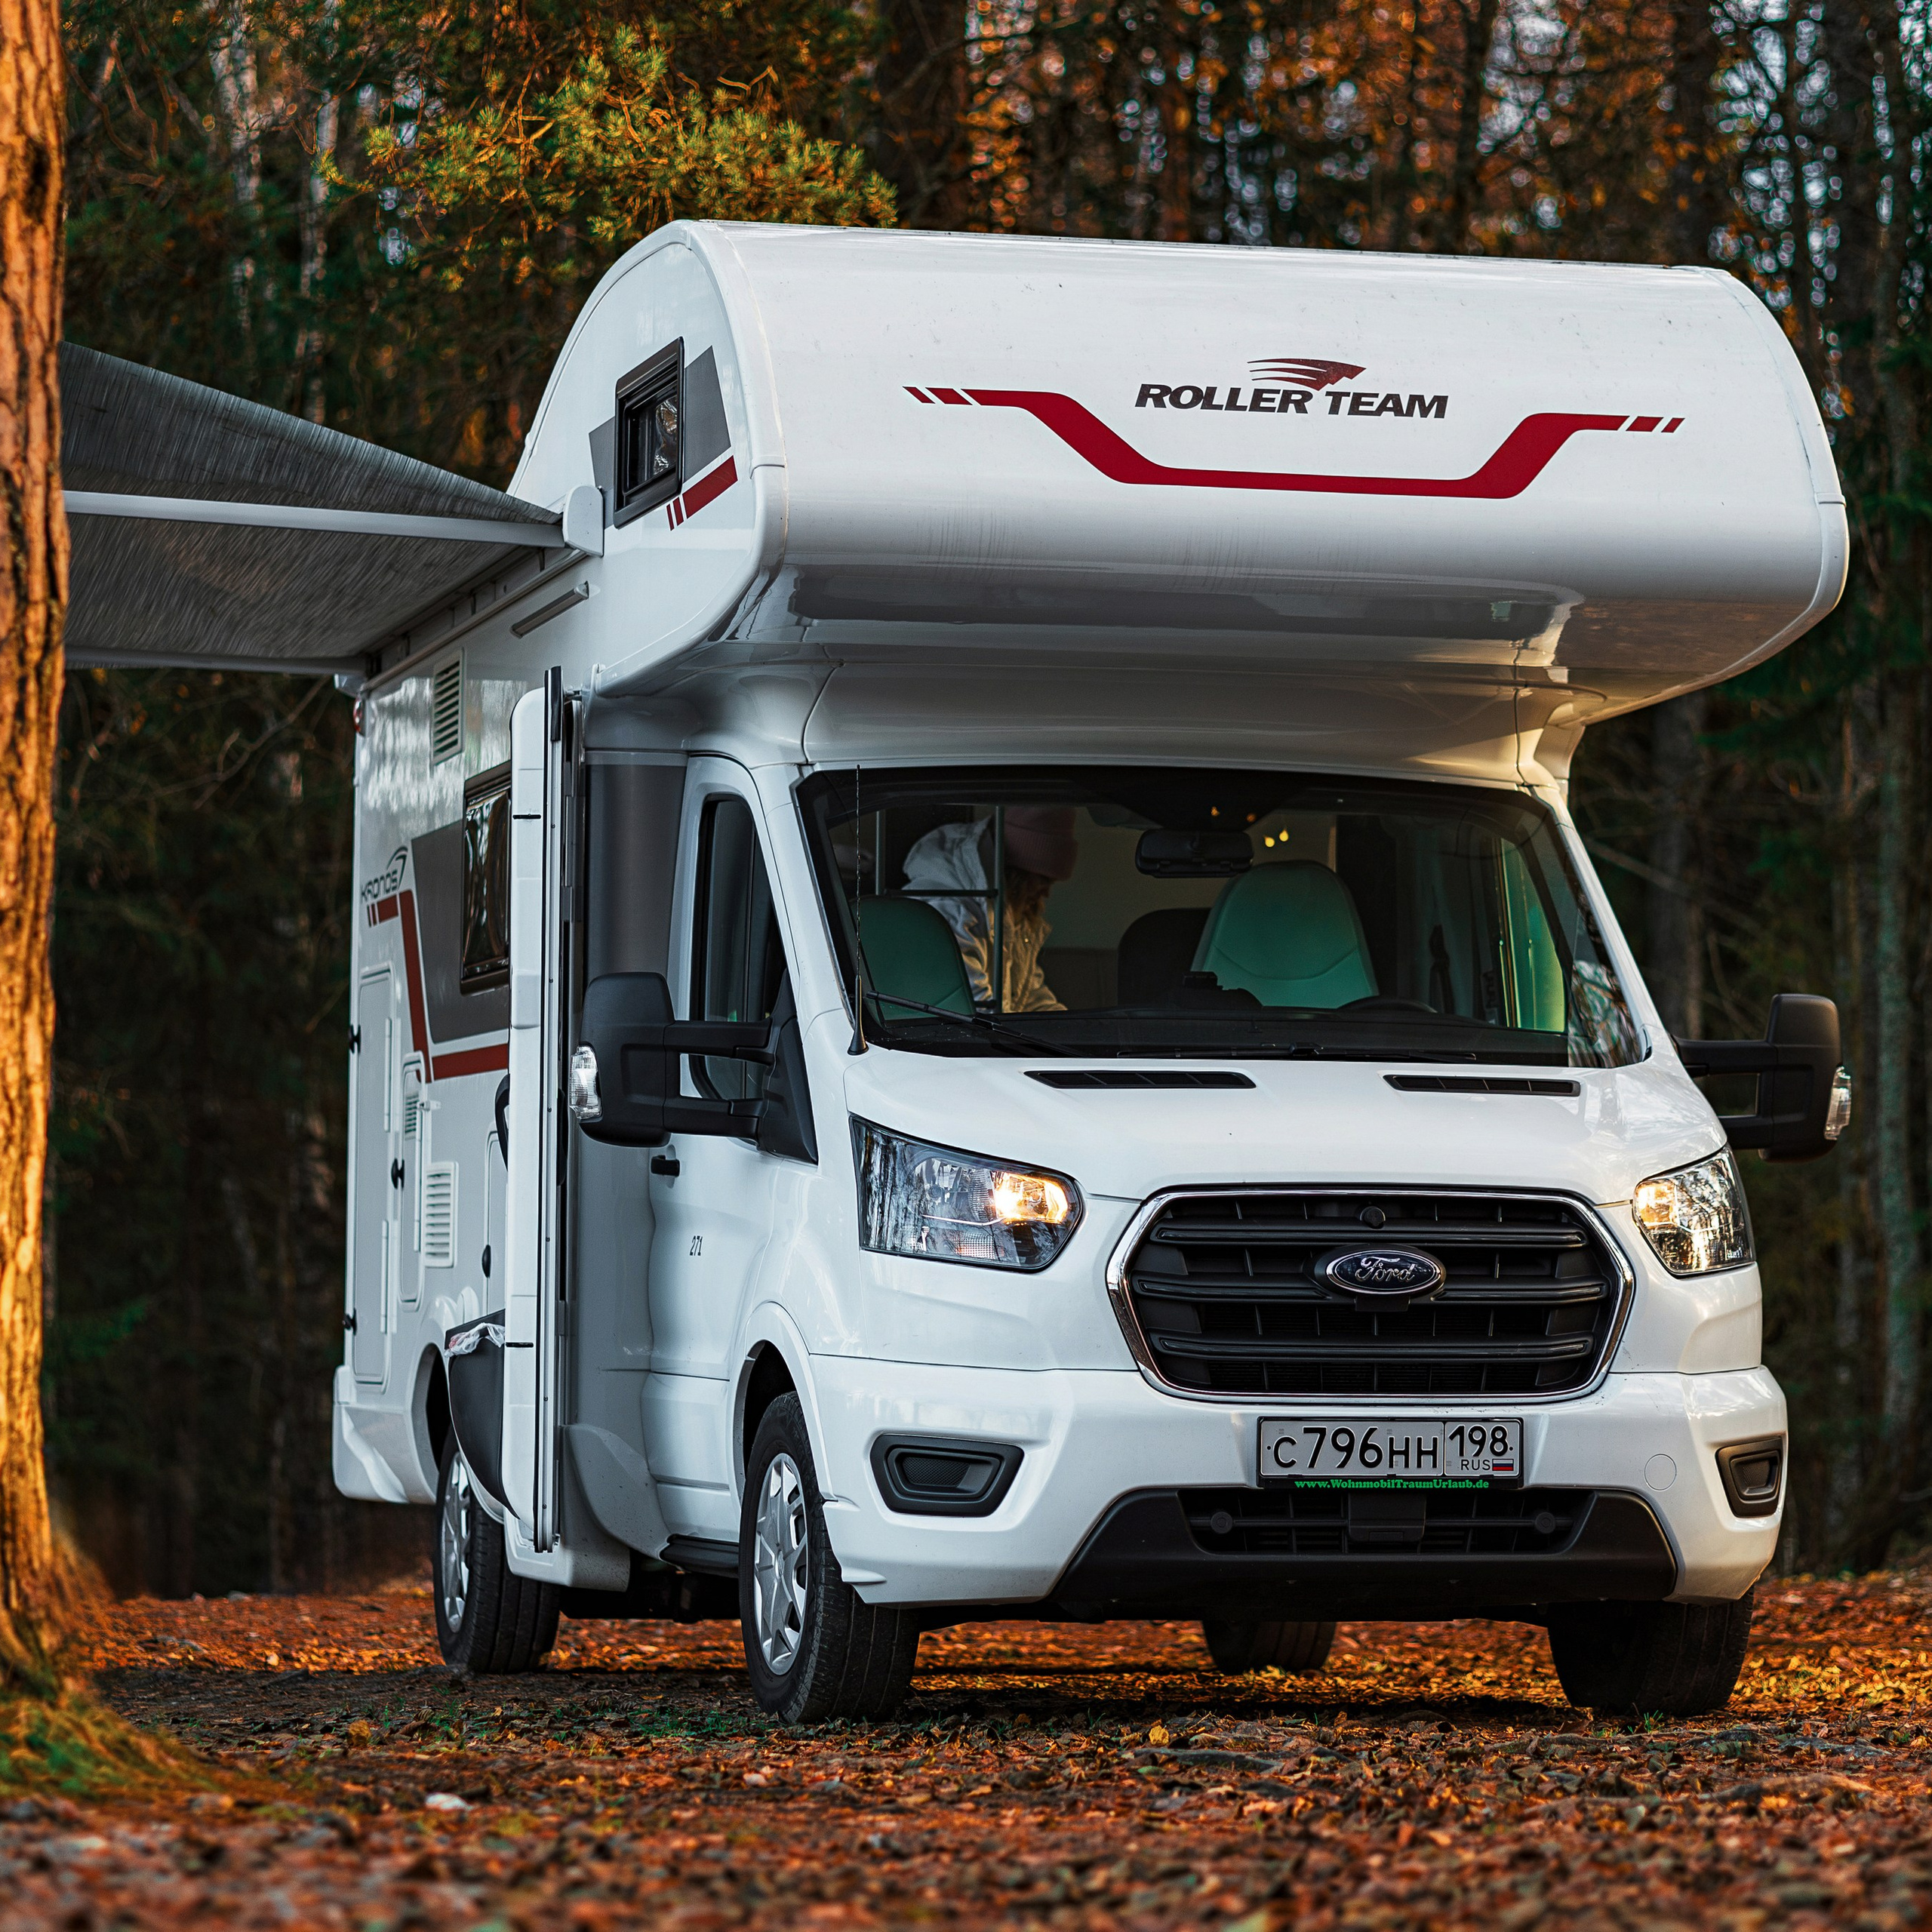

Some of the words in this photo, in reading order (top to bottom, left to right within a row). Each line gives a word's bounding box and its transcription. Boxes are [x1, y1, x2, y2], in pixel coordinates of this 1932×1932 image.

[1135, 383, 1313, 414] ROLLER
[1324, 390, 1449, 419] TEAM
[689, 1235, 703, 1257] 271
[1355, 1256, 1416, 1282] Ford
[1448, 1425, 1509, 1457] 198
[1460, 1459, 1491, 1471] RUS
[1294, 1479, 1490, 1489] www.WohnmobilTraumUrlaub.de
